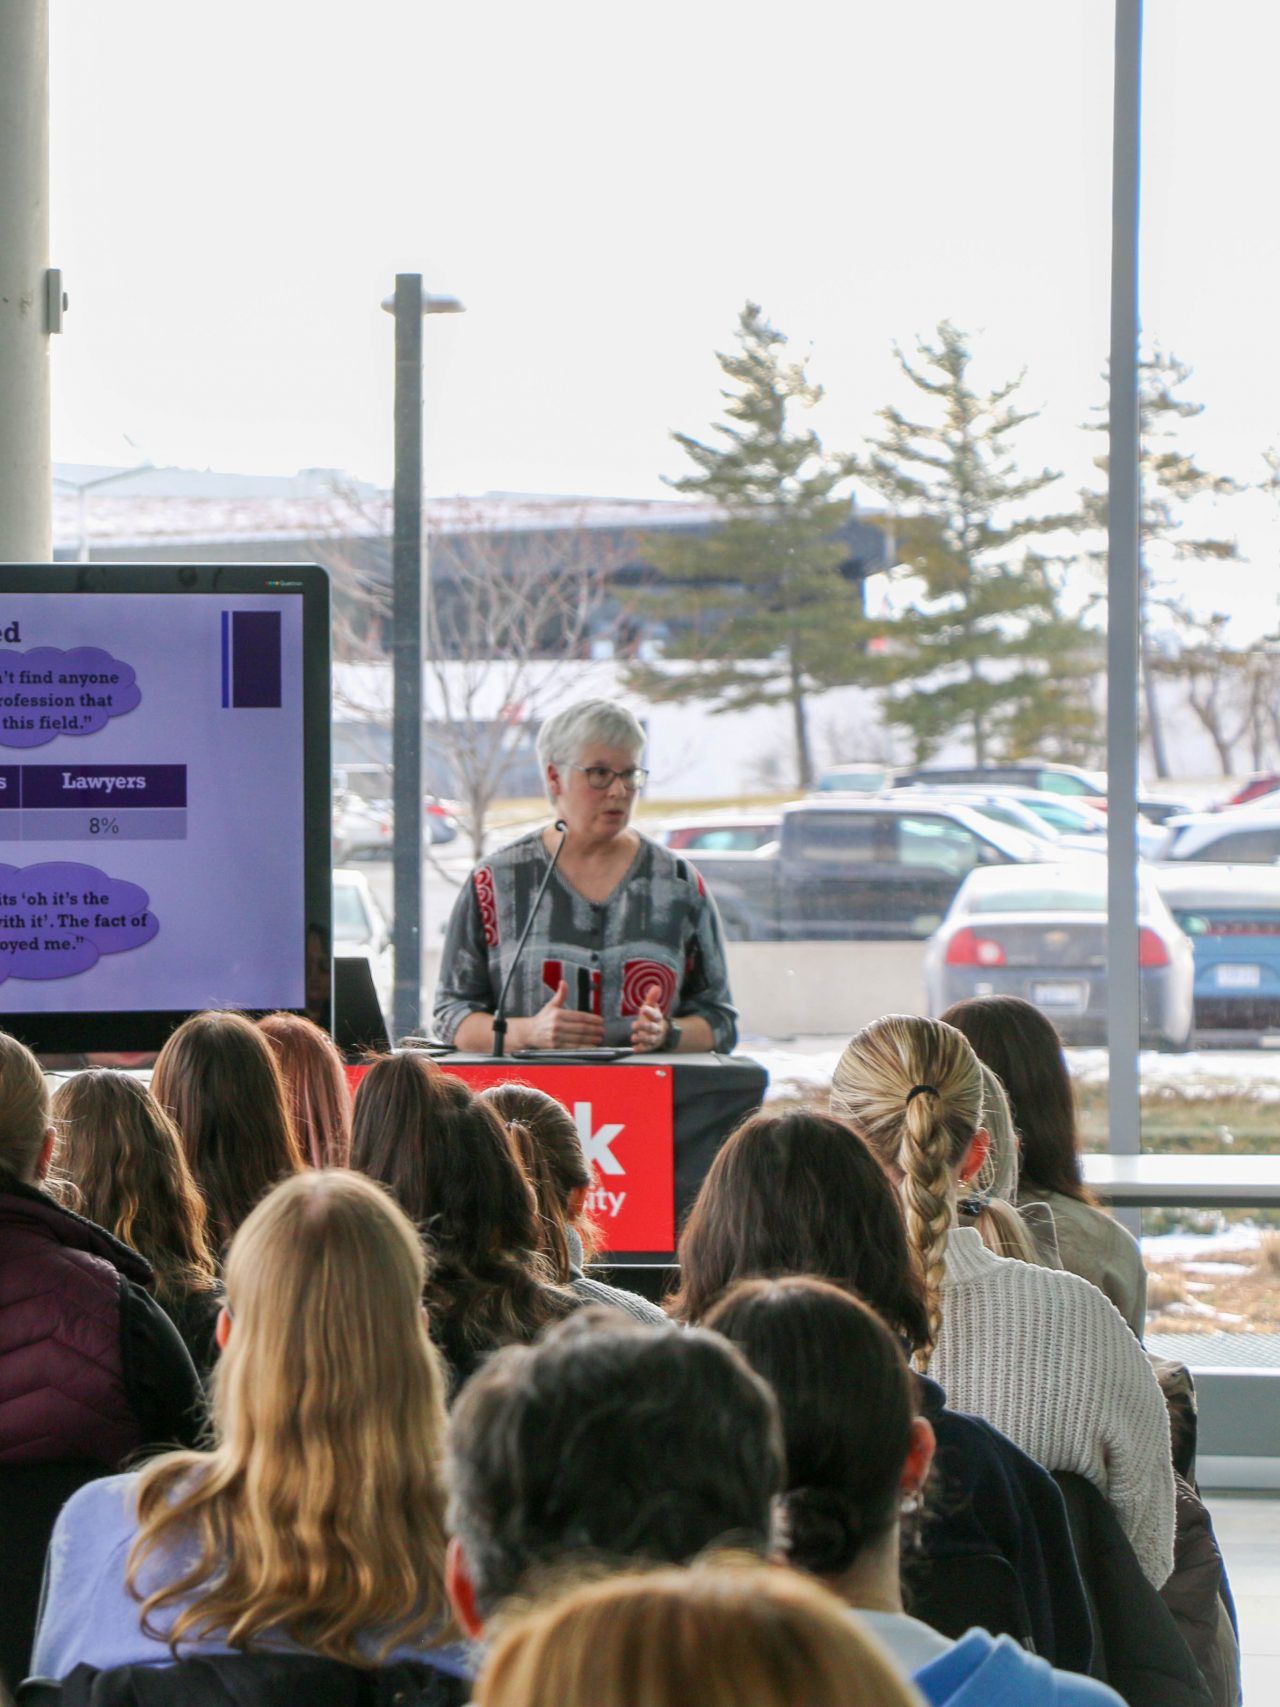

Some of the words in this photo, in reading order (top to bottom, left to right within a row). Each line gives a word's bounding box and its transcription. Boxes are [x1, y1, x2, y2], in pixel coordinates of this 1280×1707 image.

[19, 670, 53, 684] find
[58, 673, 119, 687] anyone
[79, 694, 112, 707] that
[2, 716, 34, 729] this
[62, 772, 147, 793] Lawyers
[88, 817, 119, 834] 8%
[83, 891, 110, 905] the
[58, 914, 90, 928] The
[94, 914, 127, 928] fact
[131, 913, 149, 927] of
